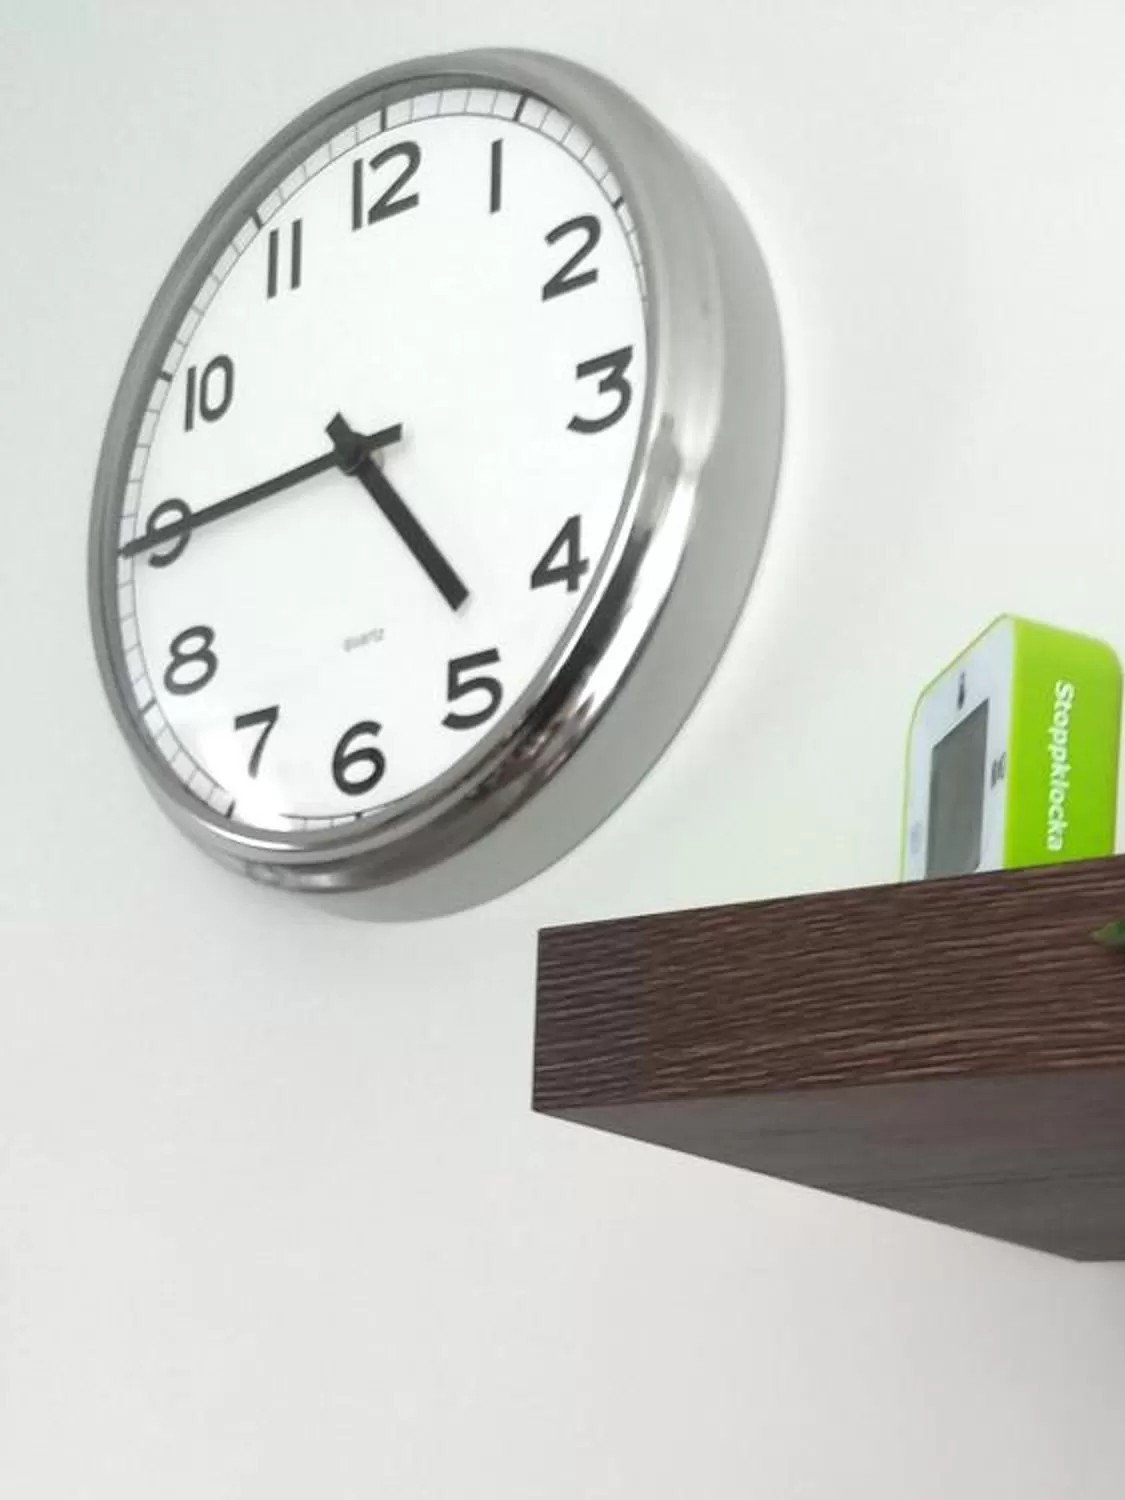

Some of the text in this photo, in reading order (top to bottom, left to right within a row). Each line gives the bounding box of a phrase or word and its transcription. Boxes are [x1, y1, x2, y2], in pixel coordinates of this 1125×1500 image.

[352, 140, 421, 231] 12
[489, 138, 503, 214] 1
[266, 219, 303, 298] 11
[541, 214, 602, 302] 2
[184, 354, 234, 432] 10
[566, 345, 634, 434] 3
[145, 497, 193, 569] 9
[529, 514, 589, 593] 4
[163, 625, 218, 695] 8
[441, 647, 503, 731] 5
[232, 704, 281, 778] 7
[331, 720, 386, 797] 6
[1047, 679, 1075, 850] Stoppklocka
